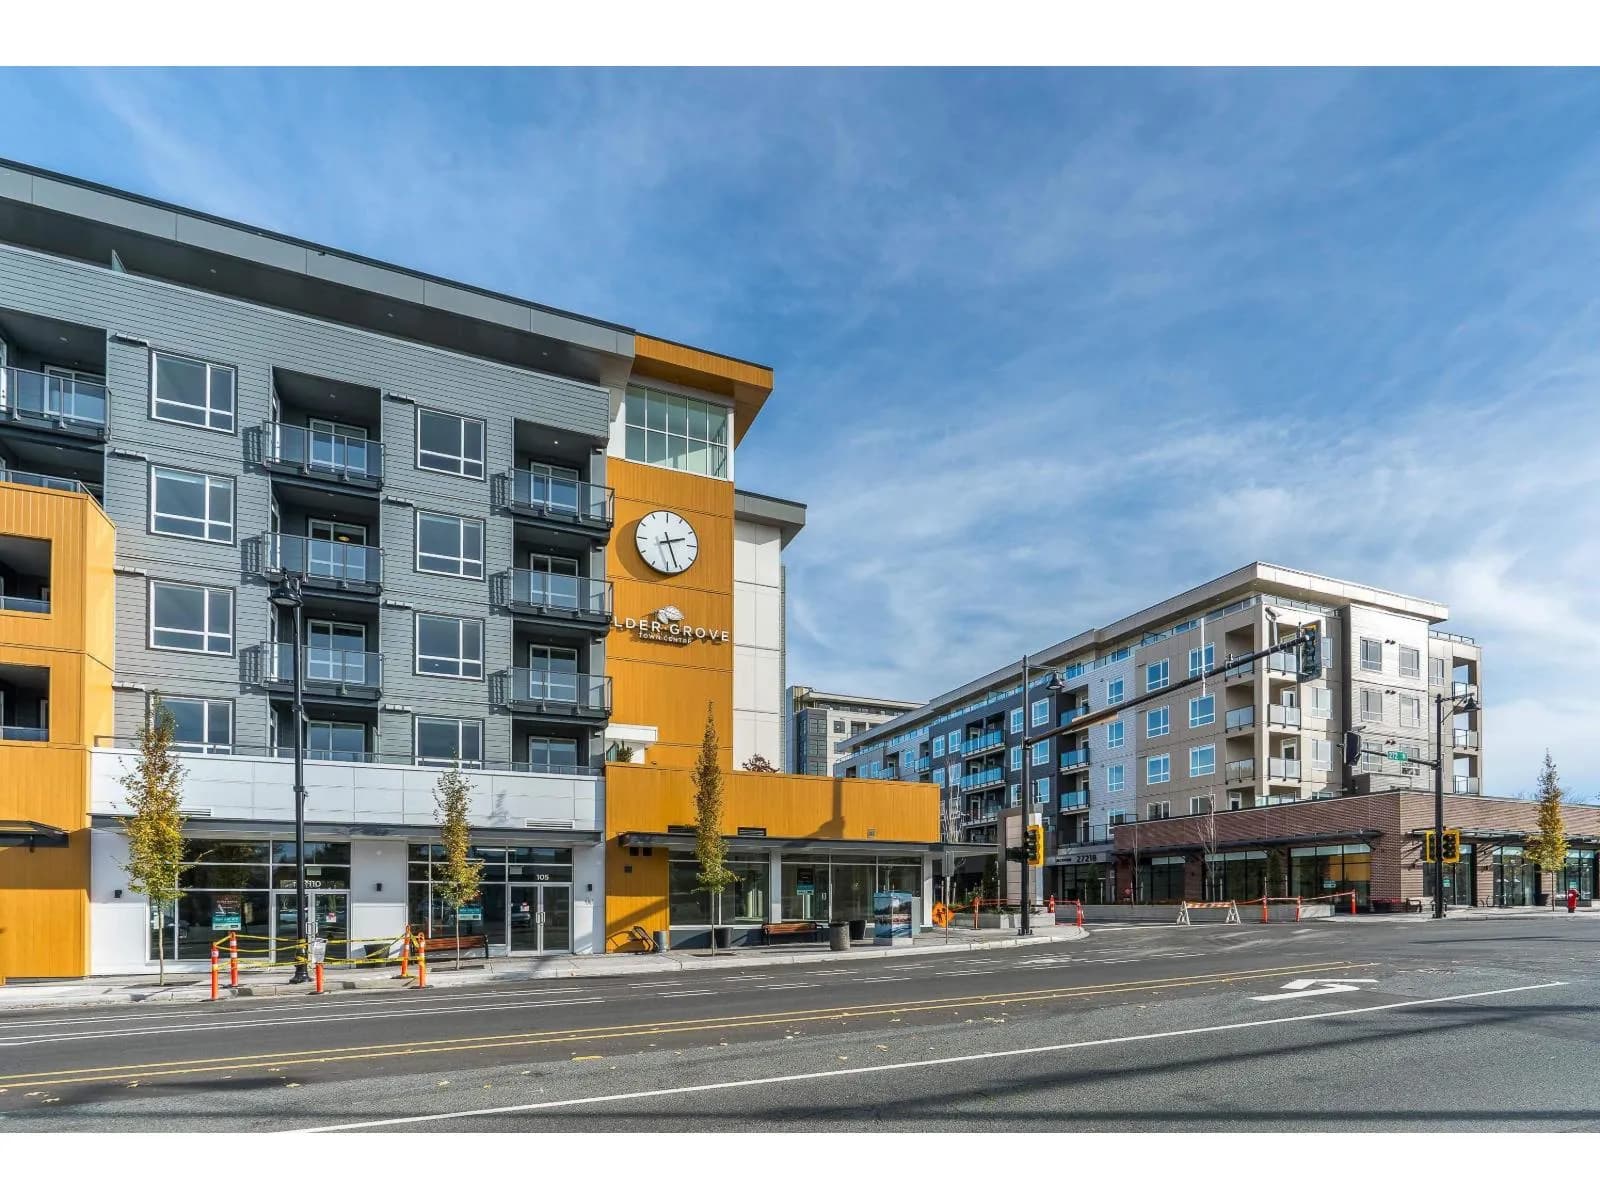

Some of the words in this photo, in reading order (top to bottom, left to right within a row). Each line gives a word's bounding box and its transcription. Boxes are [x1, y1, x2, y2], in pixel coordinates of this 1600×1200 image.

[613, 615, 661, 632] LDER
[669, 623, 730, 641] GROVE
[638, 631, 661, 640] TOWN
[1388, 751, 1398, 760] 272
